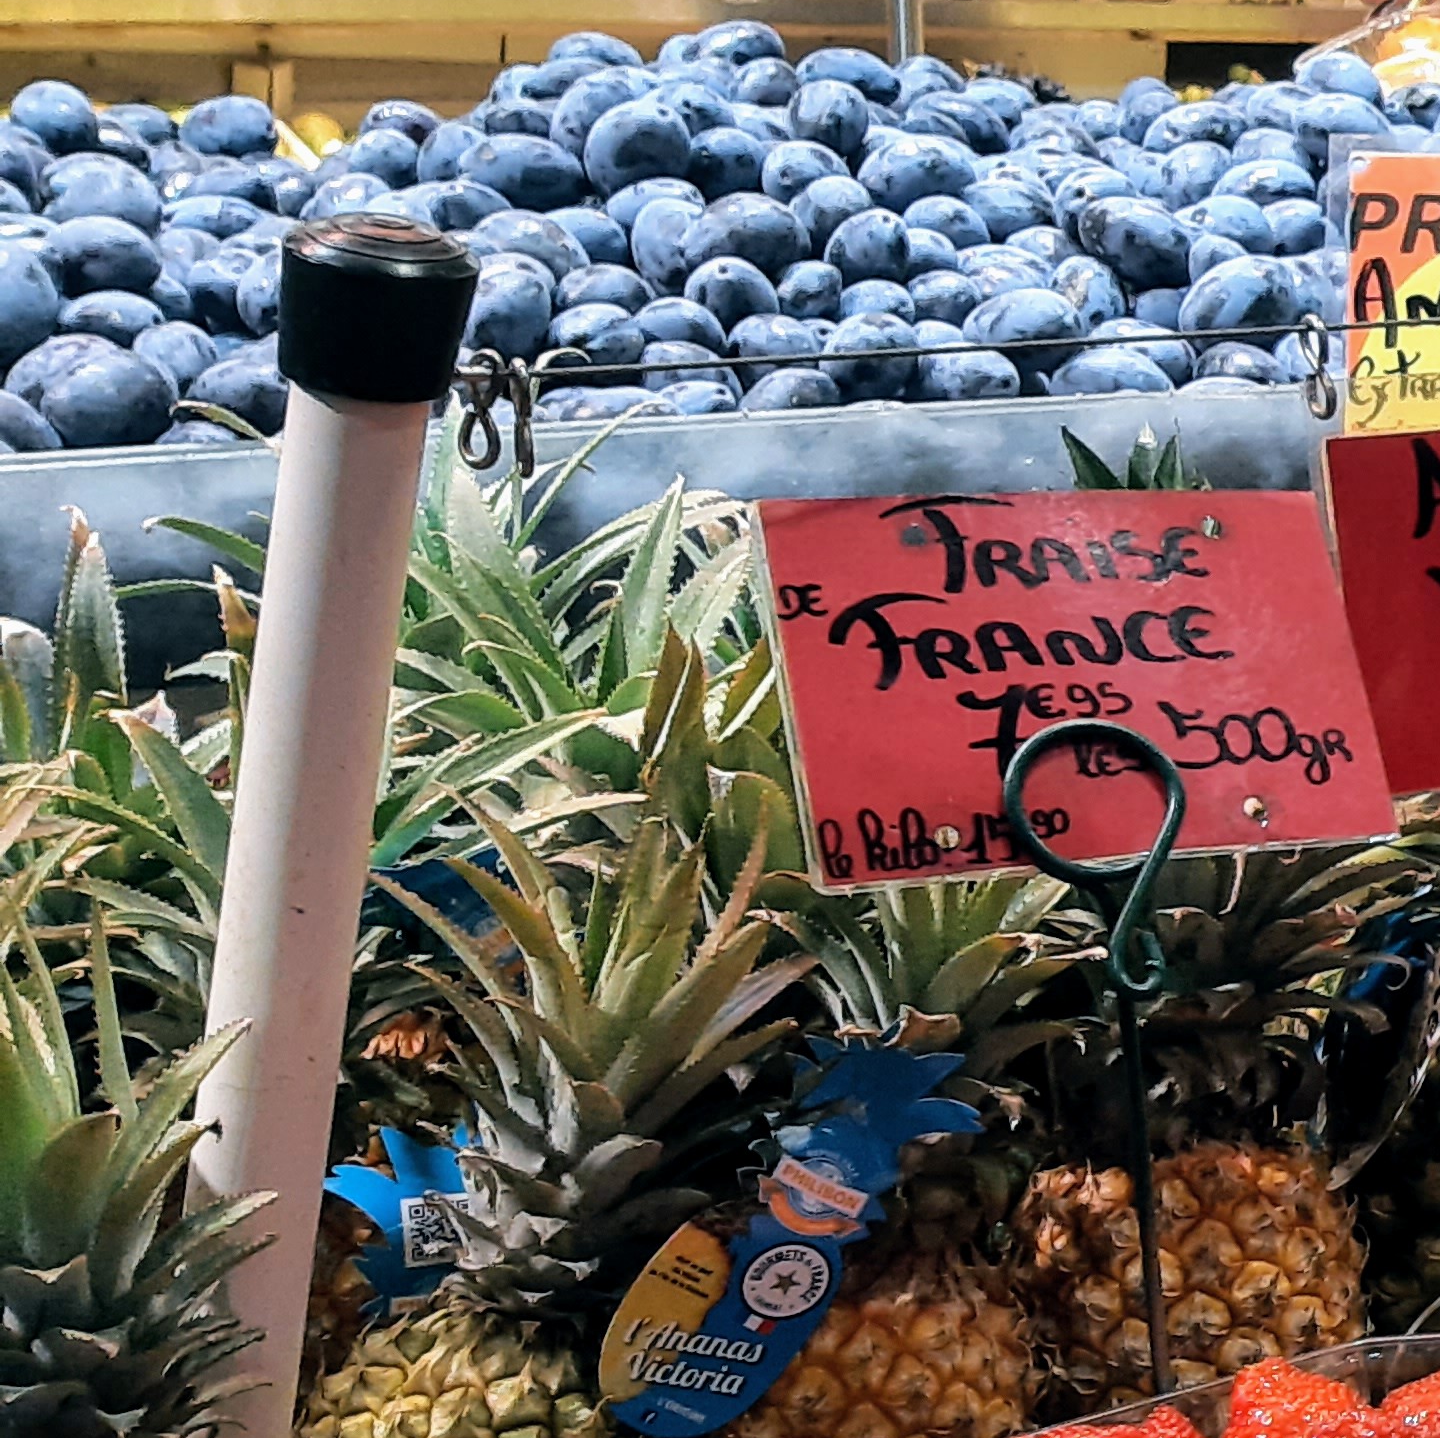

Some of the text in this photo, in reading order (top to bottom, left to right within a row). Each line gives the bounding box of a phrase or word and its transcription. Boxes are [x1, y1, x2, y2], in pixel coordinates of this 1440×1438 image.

[879, 495, 1212, 594] FRAISE
[778, 584, 1235, 691] DE FRANCE
[626, 1350, 745, 1395] Victoria
